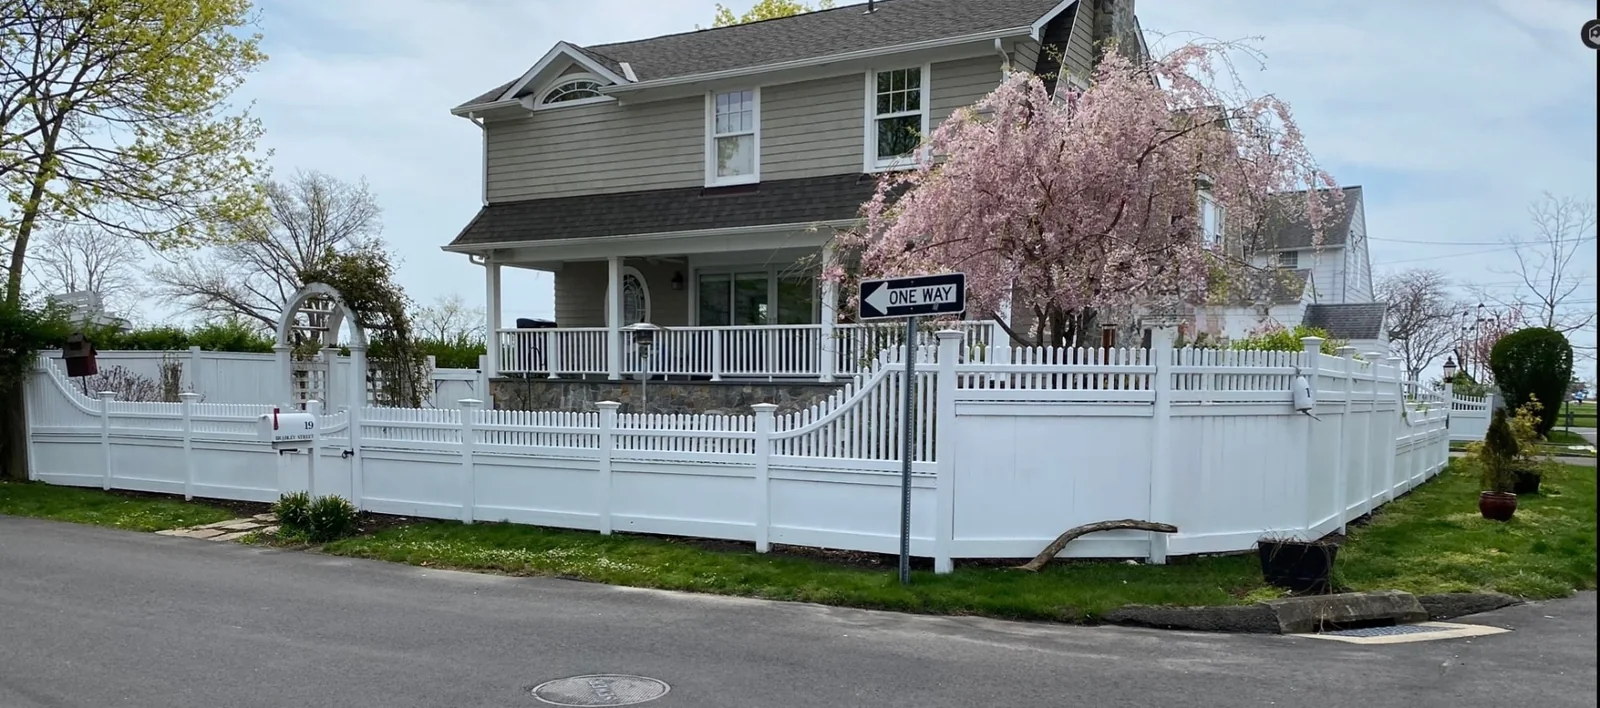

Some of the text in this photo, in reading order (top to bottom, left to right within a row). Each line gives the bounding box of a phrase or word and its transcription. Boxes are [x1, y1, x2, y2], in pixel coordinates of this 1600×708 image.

[889, 286, 953, 305] ONE WAY
[304, 421, 314, 430] 19
